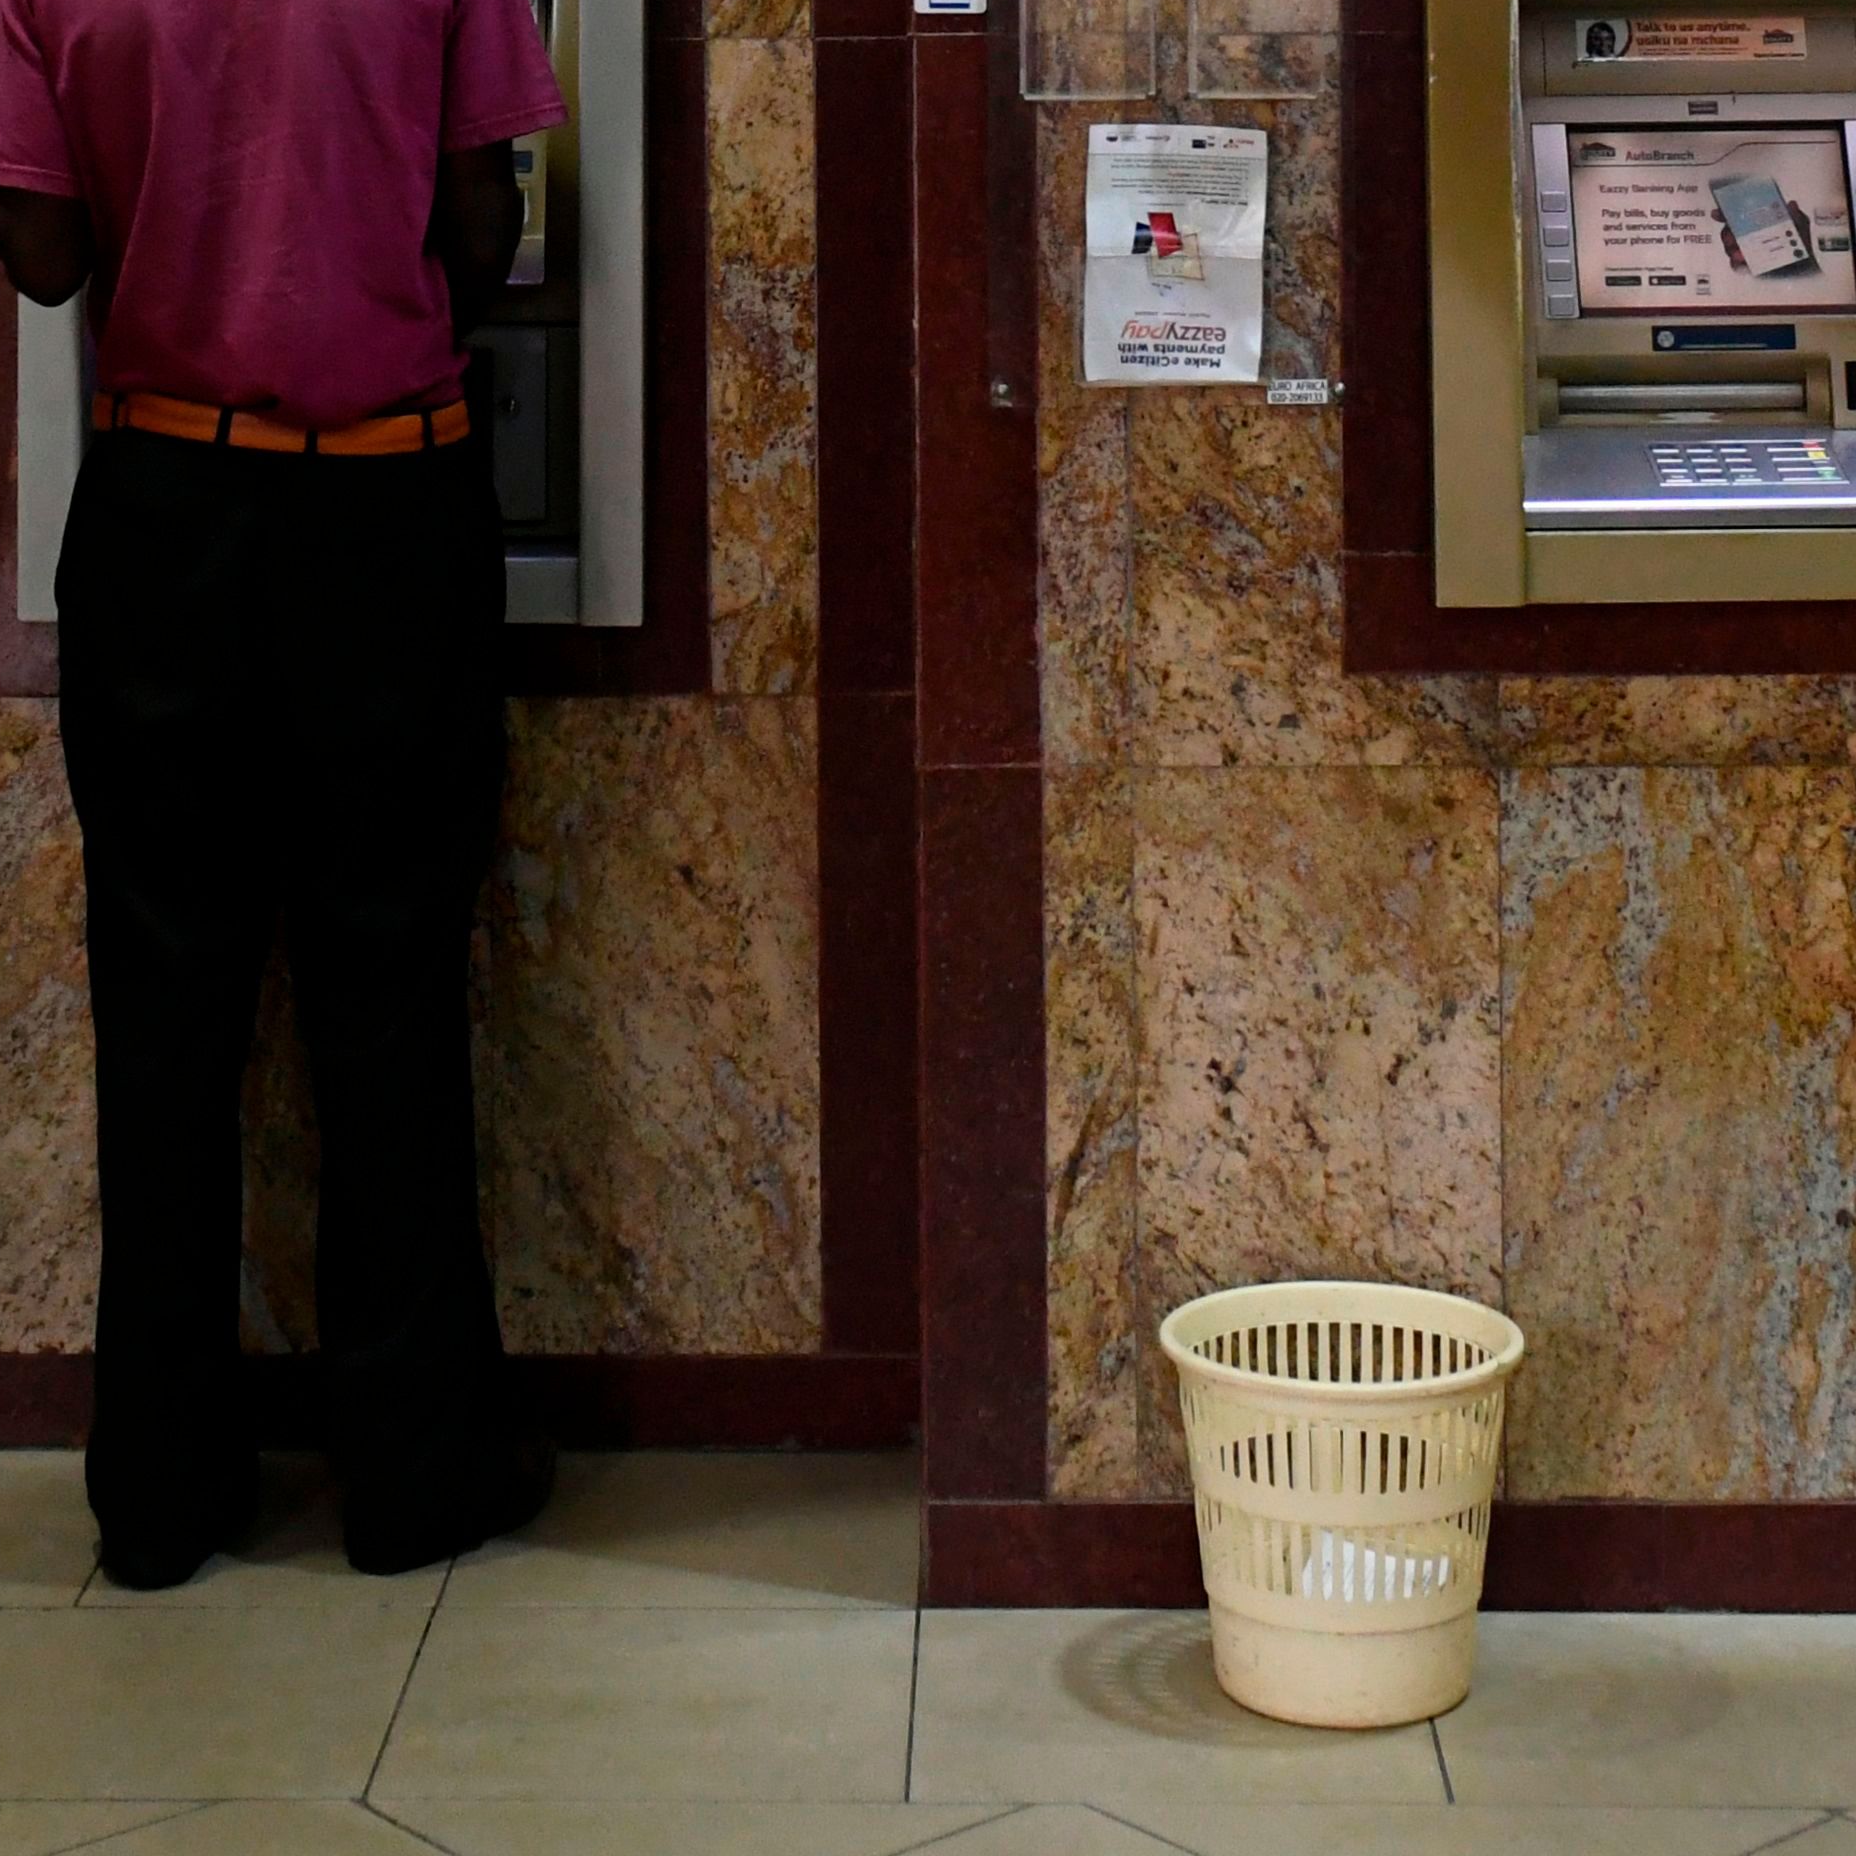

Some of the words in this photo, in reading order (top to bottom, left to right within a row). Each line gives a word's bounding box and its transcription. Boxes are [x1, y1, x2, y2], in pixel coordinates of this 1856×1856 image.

[1626, 149, 1694, 161] AutoBranch
[1602, 209, 1621, 219] Pay
[1624, 209, 1647, 218] bills,
[1650, 209, 1669, 218] buy
[1673, 208, 1706, 219] goods
[1603, 223, 1623, 231] and
[1671, 221, 1696, 230] from
[1603, 238, 1628, 246] your
[1630, 237, 1664, 246] phone
[1666, 235, 1680, 244] for
[1683, 235, 1712, 244] FREE
[1121, 320, 1226, 341] eazzypay
[1118, 343, 1148, 354] with
[1154, 344, 1225, 354] payments
[1120, 355, 1179, 367] eCitizen
[1184, 357, 1221, 368] Make
[1296, 382, 1326, 390] AFRICA
